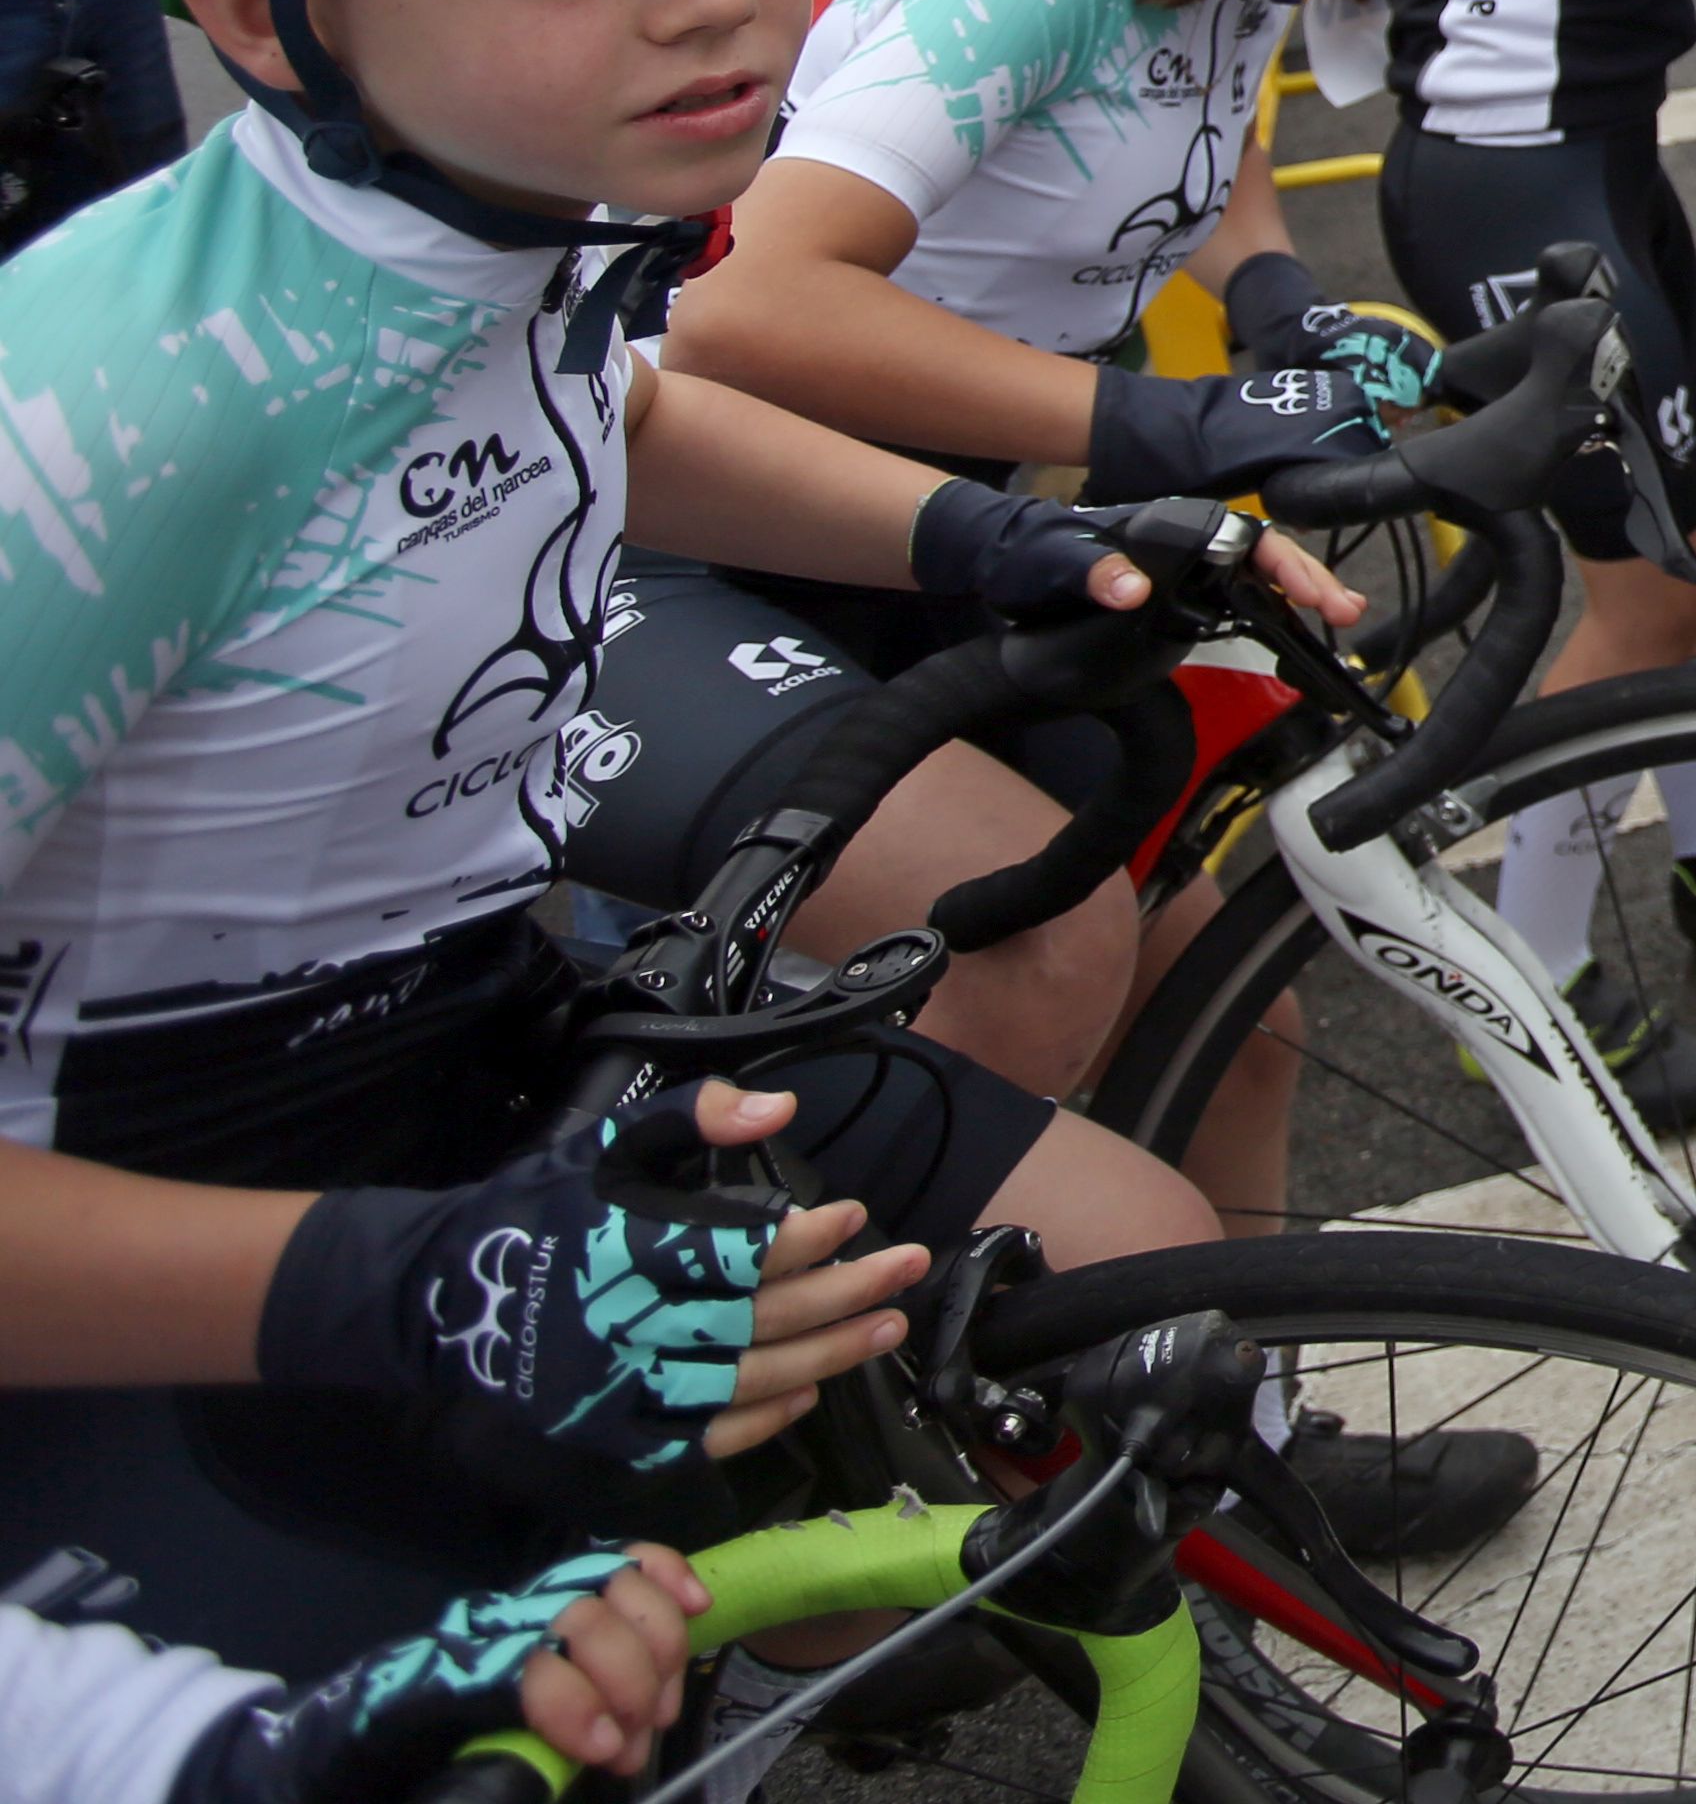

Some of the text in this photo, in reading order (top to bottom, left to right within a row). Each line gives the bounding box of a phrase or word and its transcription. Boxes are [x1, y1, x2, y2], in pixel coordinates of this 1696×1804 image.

[444, 505, 501, 543] TURISMO
[461, 487, 489, 519] del
[1375, 941, 1514, 1037] ONDA
[518, 1233, 561, 1400] CICLOASTUR
